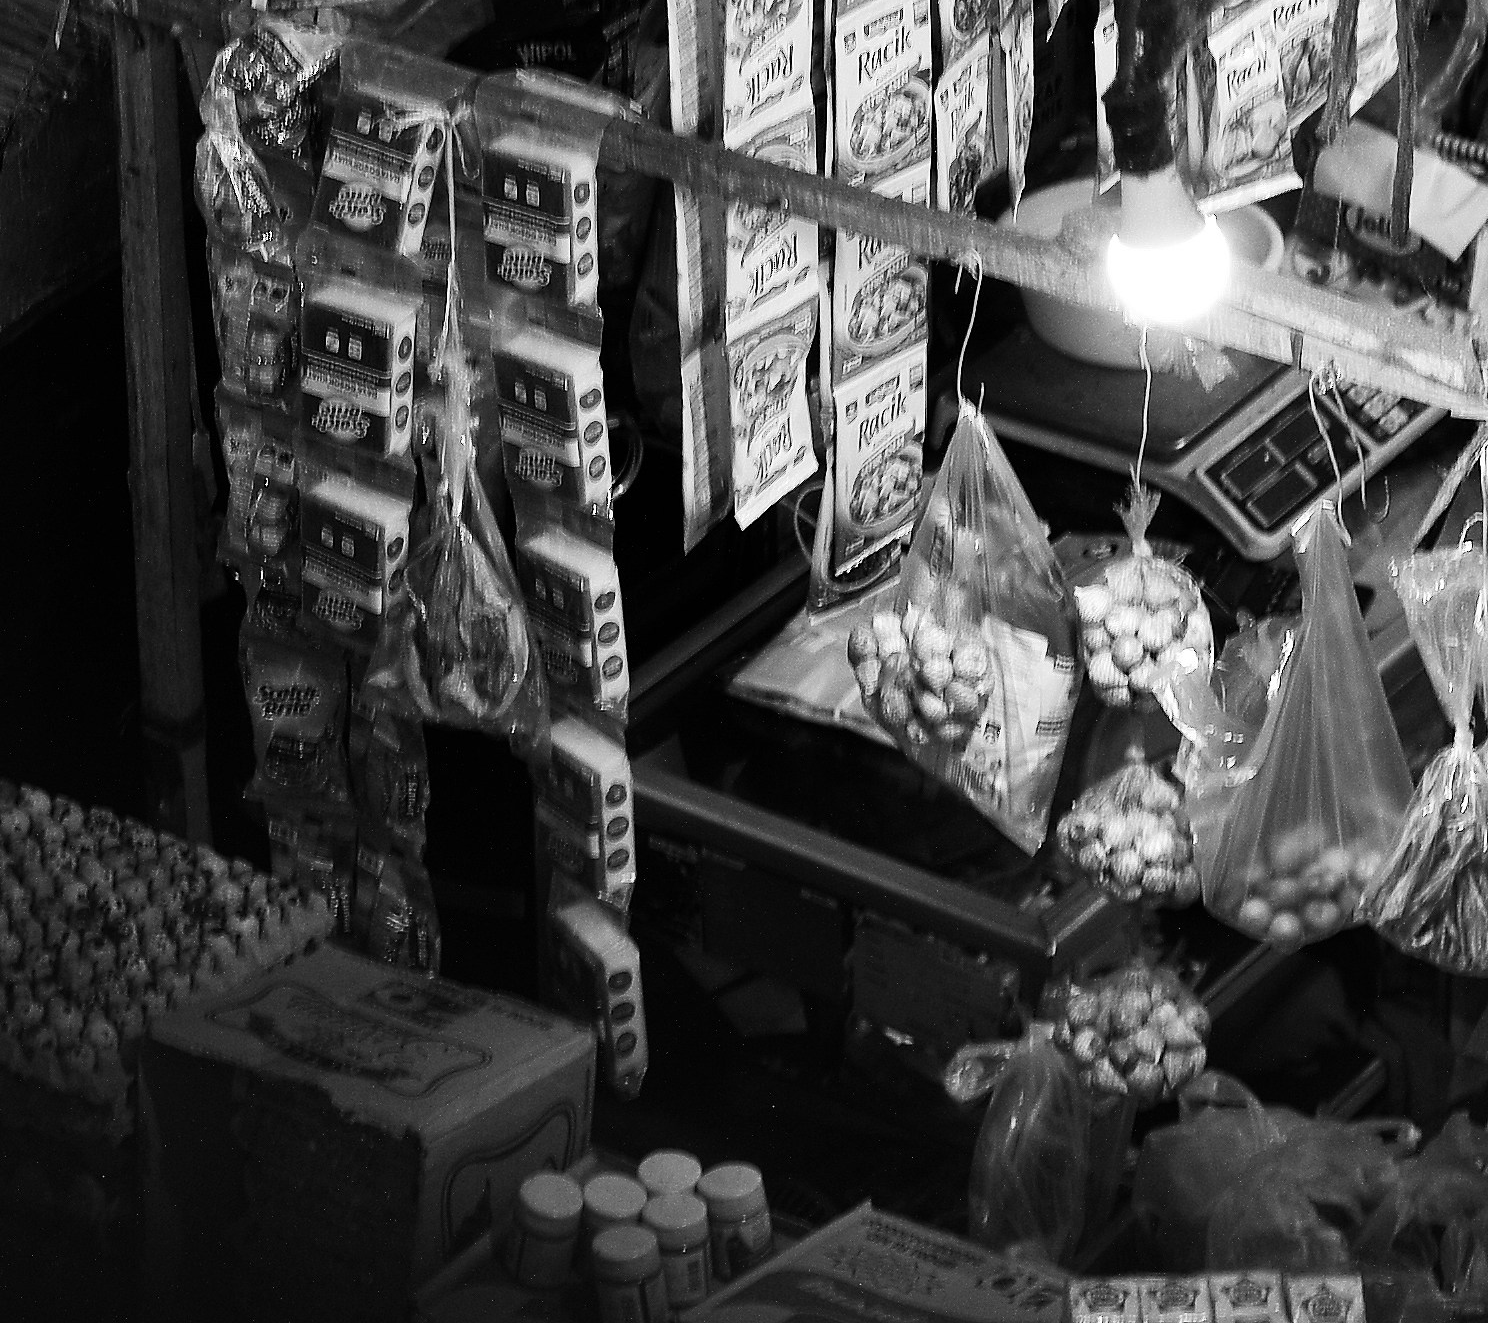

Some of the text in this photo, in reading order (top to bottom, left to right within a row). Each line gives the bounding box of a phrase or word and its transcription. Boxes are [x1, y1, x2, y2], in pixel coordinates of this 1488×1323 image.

[744, 43, 795, 107] Racik
[858, 26, 913, 88] Racik
[749, 232, 798, 297] Racik
[752, 416, 792, 483] Racik
[857, 394, 908, 453] Racik
